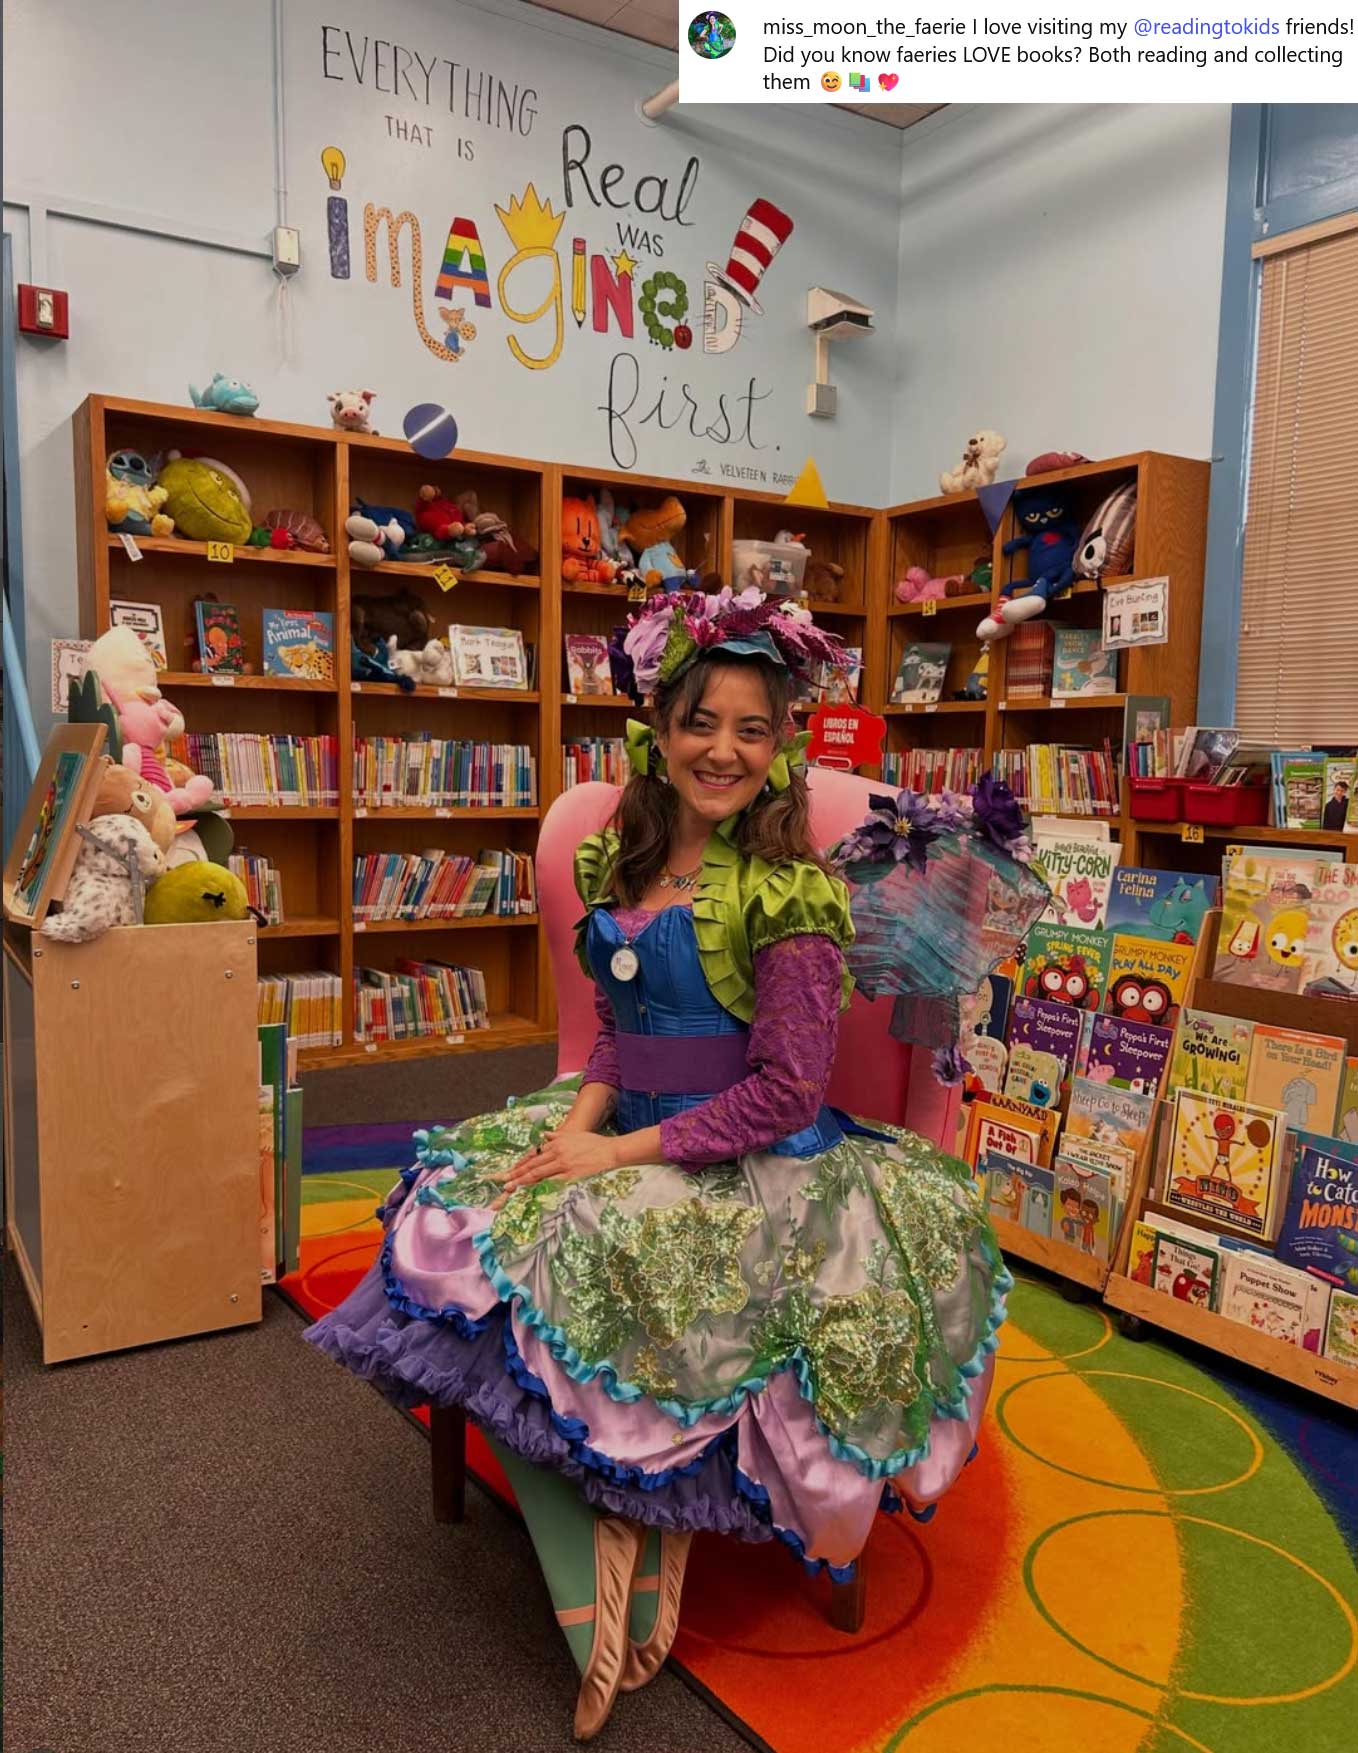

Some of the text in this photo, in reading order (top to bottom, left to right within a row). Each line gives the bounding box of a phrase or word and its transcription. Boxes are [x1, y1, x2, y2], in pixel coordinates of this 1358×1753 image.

[320, 25, 539, 137] EVERYTHING
[384, 114, 475, 162] THAT IS
[562, 124, 700, 227] Real
[616, 223, 664, 258] WAS
[597, 352, 781, 470] first.
[720, 461, 767, 483] VELVETEEN
[210, 543, 230, 560] 10
[267, 627, 313, 645] Animal
[824, 718, 859, 730] LIBROS EN
[824, 729, 854, 744] ESPAÑOL
[1186, 826, 1200, 840] 16
[1117, 870, 1158, 885] Carina
[1319, 866, 1340, 884] THE
[1120, 883, 1155, 899] Felina
[1034, 926, 1109, 948] GRUMPY MONKEY
[1114, 944, 1189, 965] GRUMPY MONKEY
[1113, 958, 1181, 980] PLAY ALL DAY
[1036, 1008, 1079, 1026] Peppa's First
[1036, 1020, 1074, 1038] Sleepover
[1120, 1027, 1169, 1049] Peppa's First
[1195, 1032, 1228, 1046] We Are
[1120, 1041, 1164, 1060] Sleepover
[1182, 1040, 1241, 1066] GROWING!
[1072, 1088, 1146, 1127] Sheep Go to Sleep
[986, 1136, 1002, 1150] Out
[988, 1126, 1016, 1144] A Fish
[1314, 1156, 1354, 1182] How
[1306, 1181, 1323, 1196] to
[1181, 1196, 1252, 1225] WRESTLES THE WORLD
[1170, 1254, 1186, 1266] That
[1174, 1246, 1197, 1260] Things
[1240, 1271, 1270, 1288] Puppet
[1272, 1282, 1297, 1298] Show
